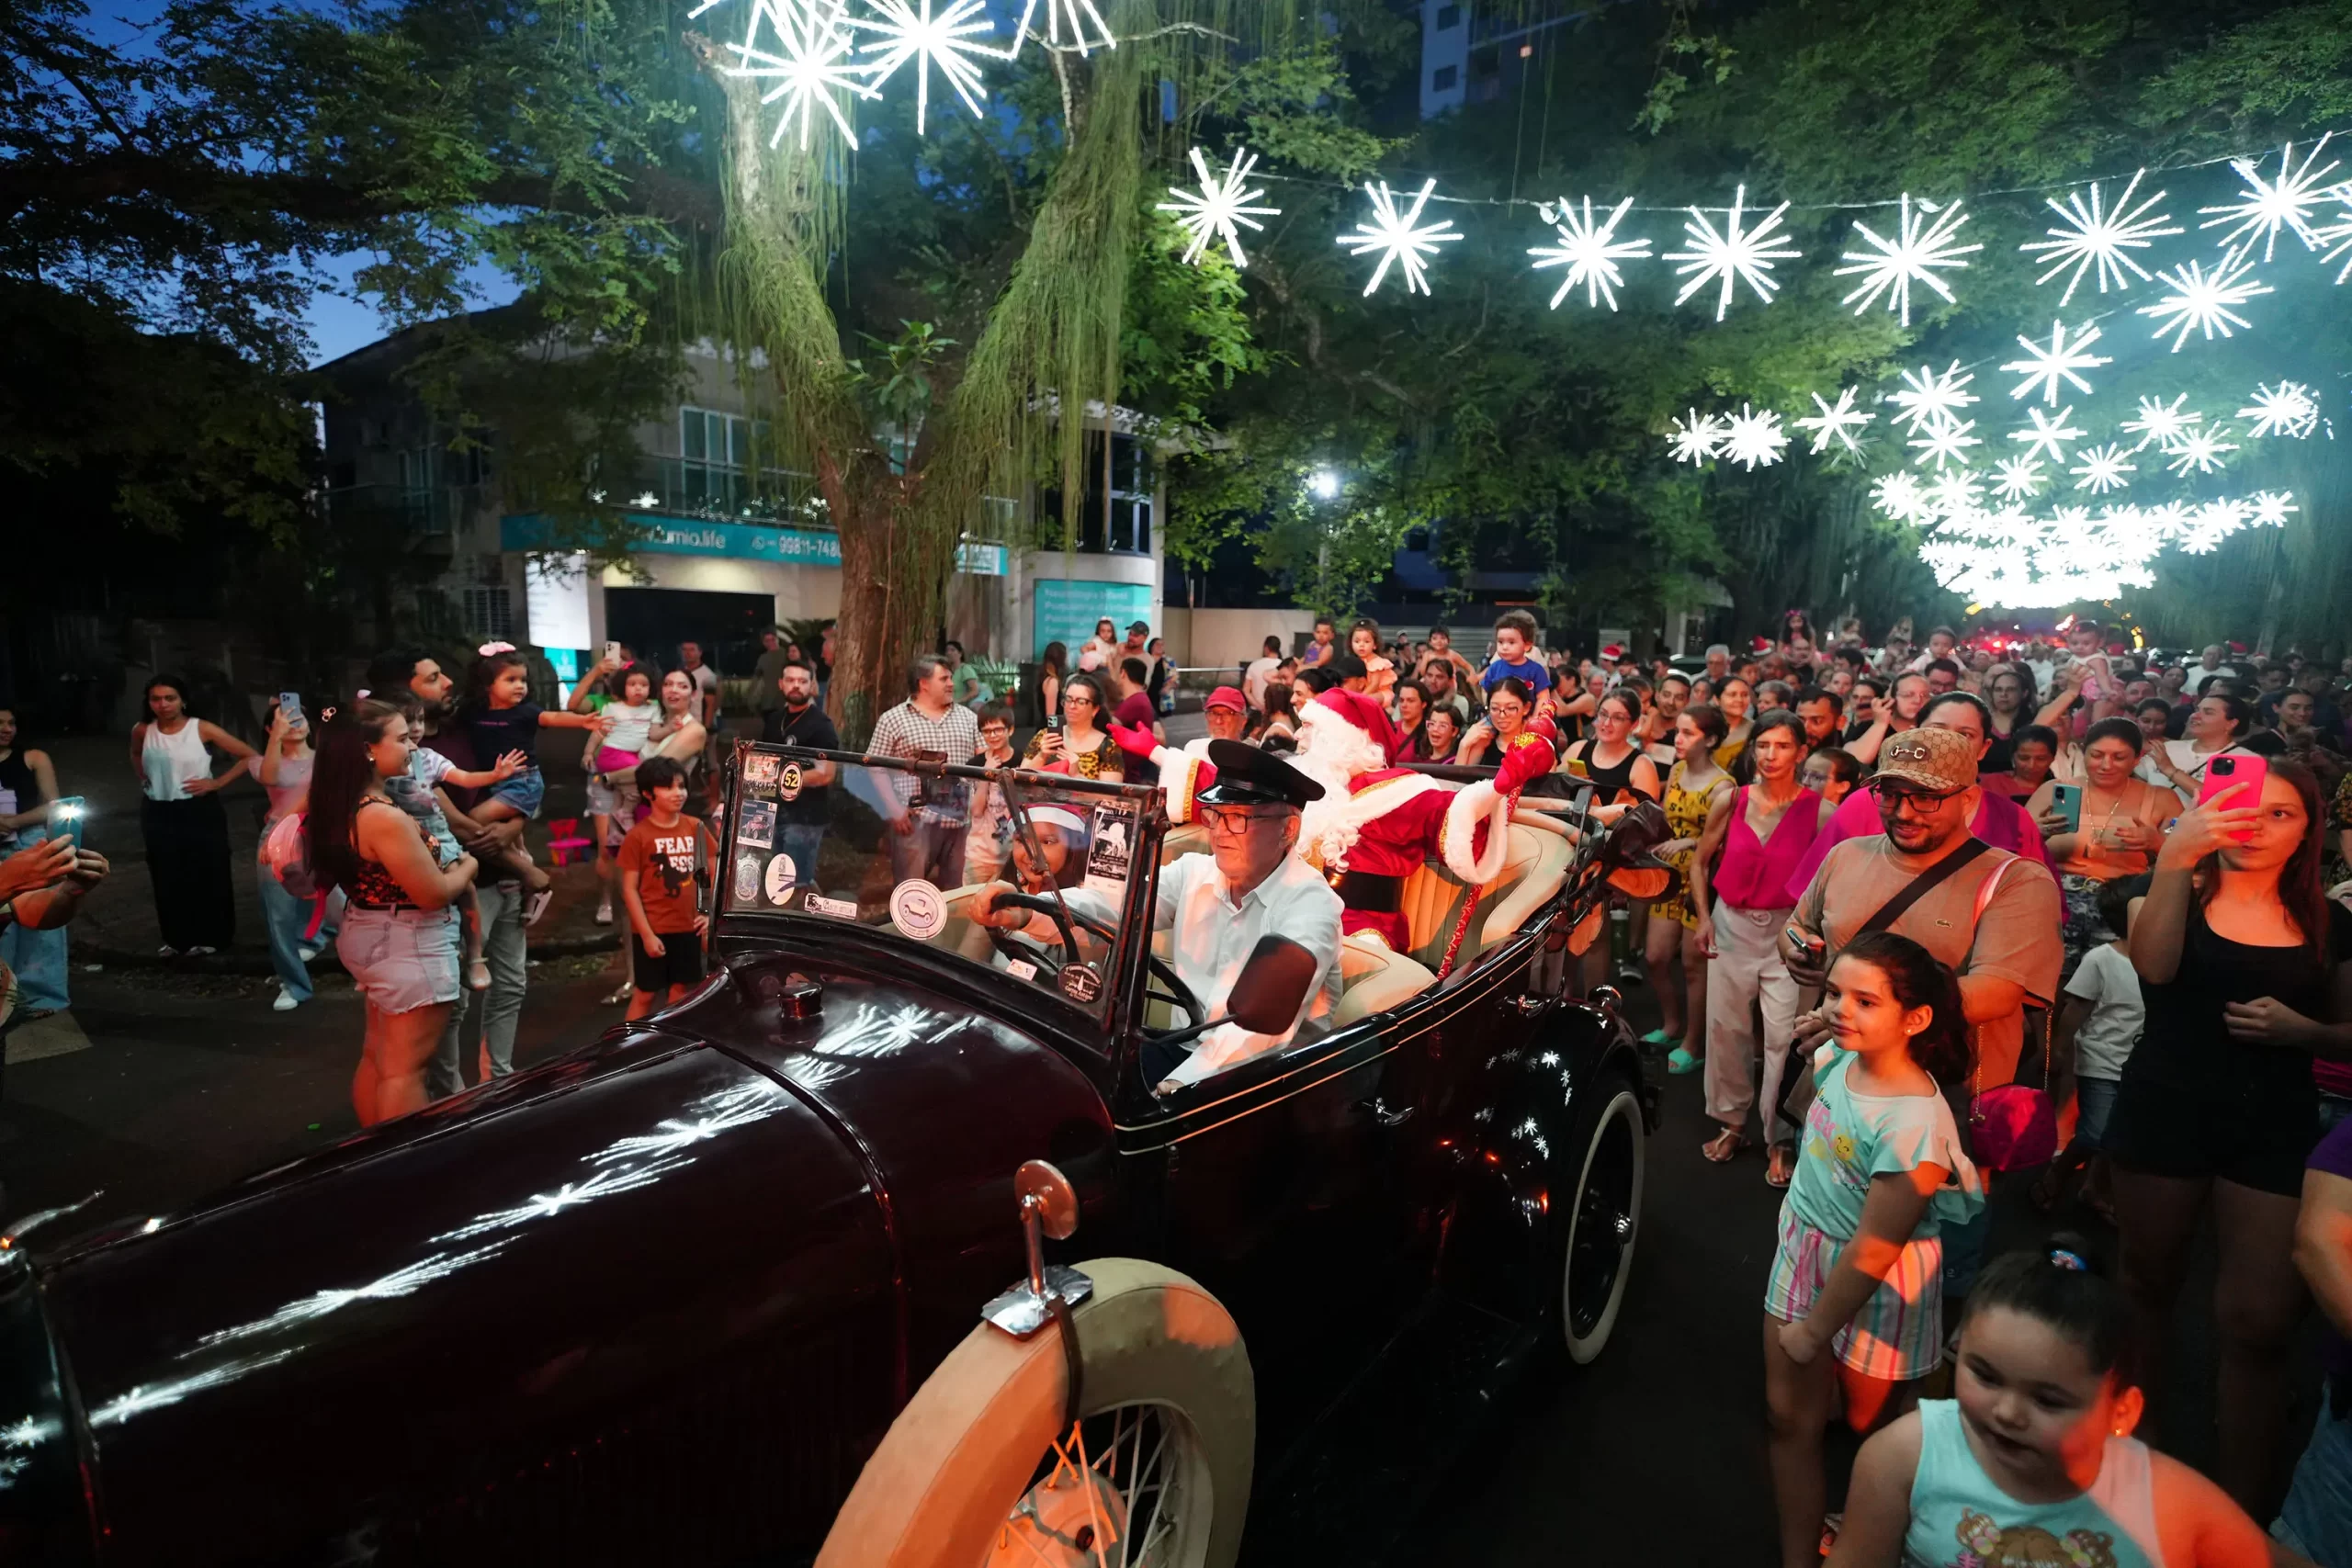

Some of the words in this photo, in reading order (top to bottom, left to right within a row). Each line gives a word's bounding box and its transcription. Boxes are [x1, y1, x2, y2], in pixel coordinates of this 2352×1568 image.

[785, 773, 797, 787] 52
[654, 836, 694, 854] FEAR
[660, 855, 694, 873] ESS
